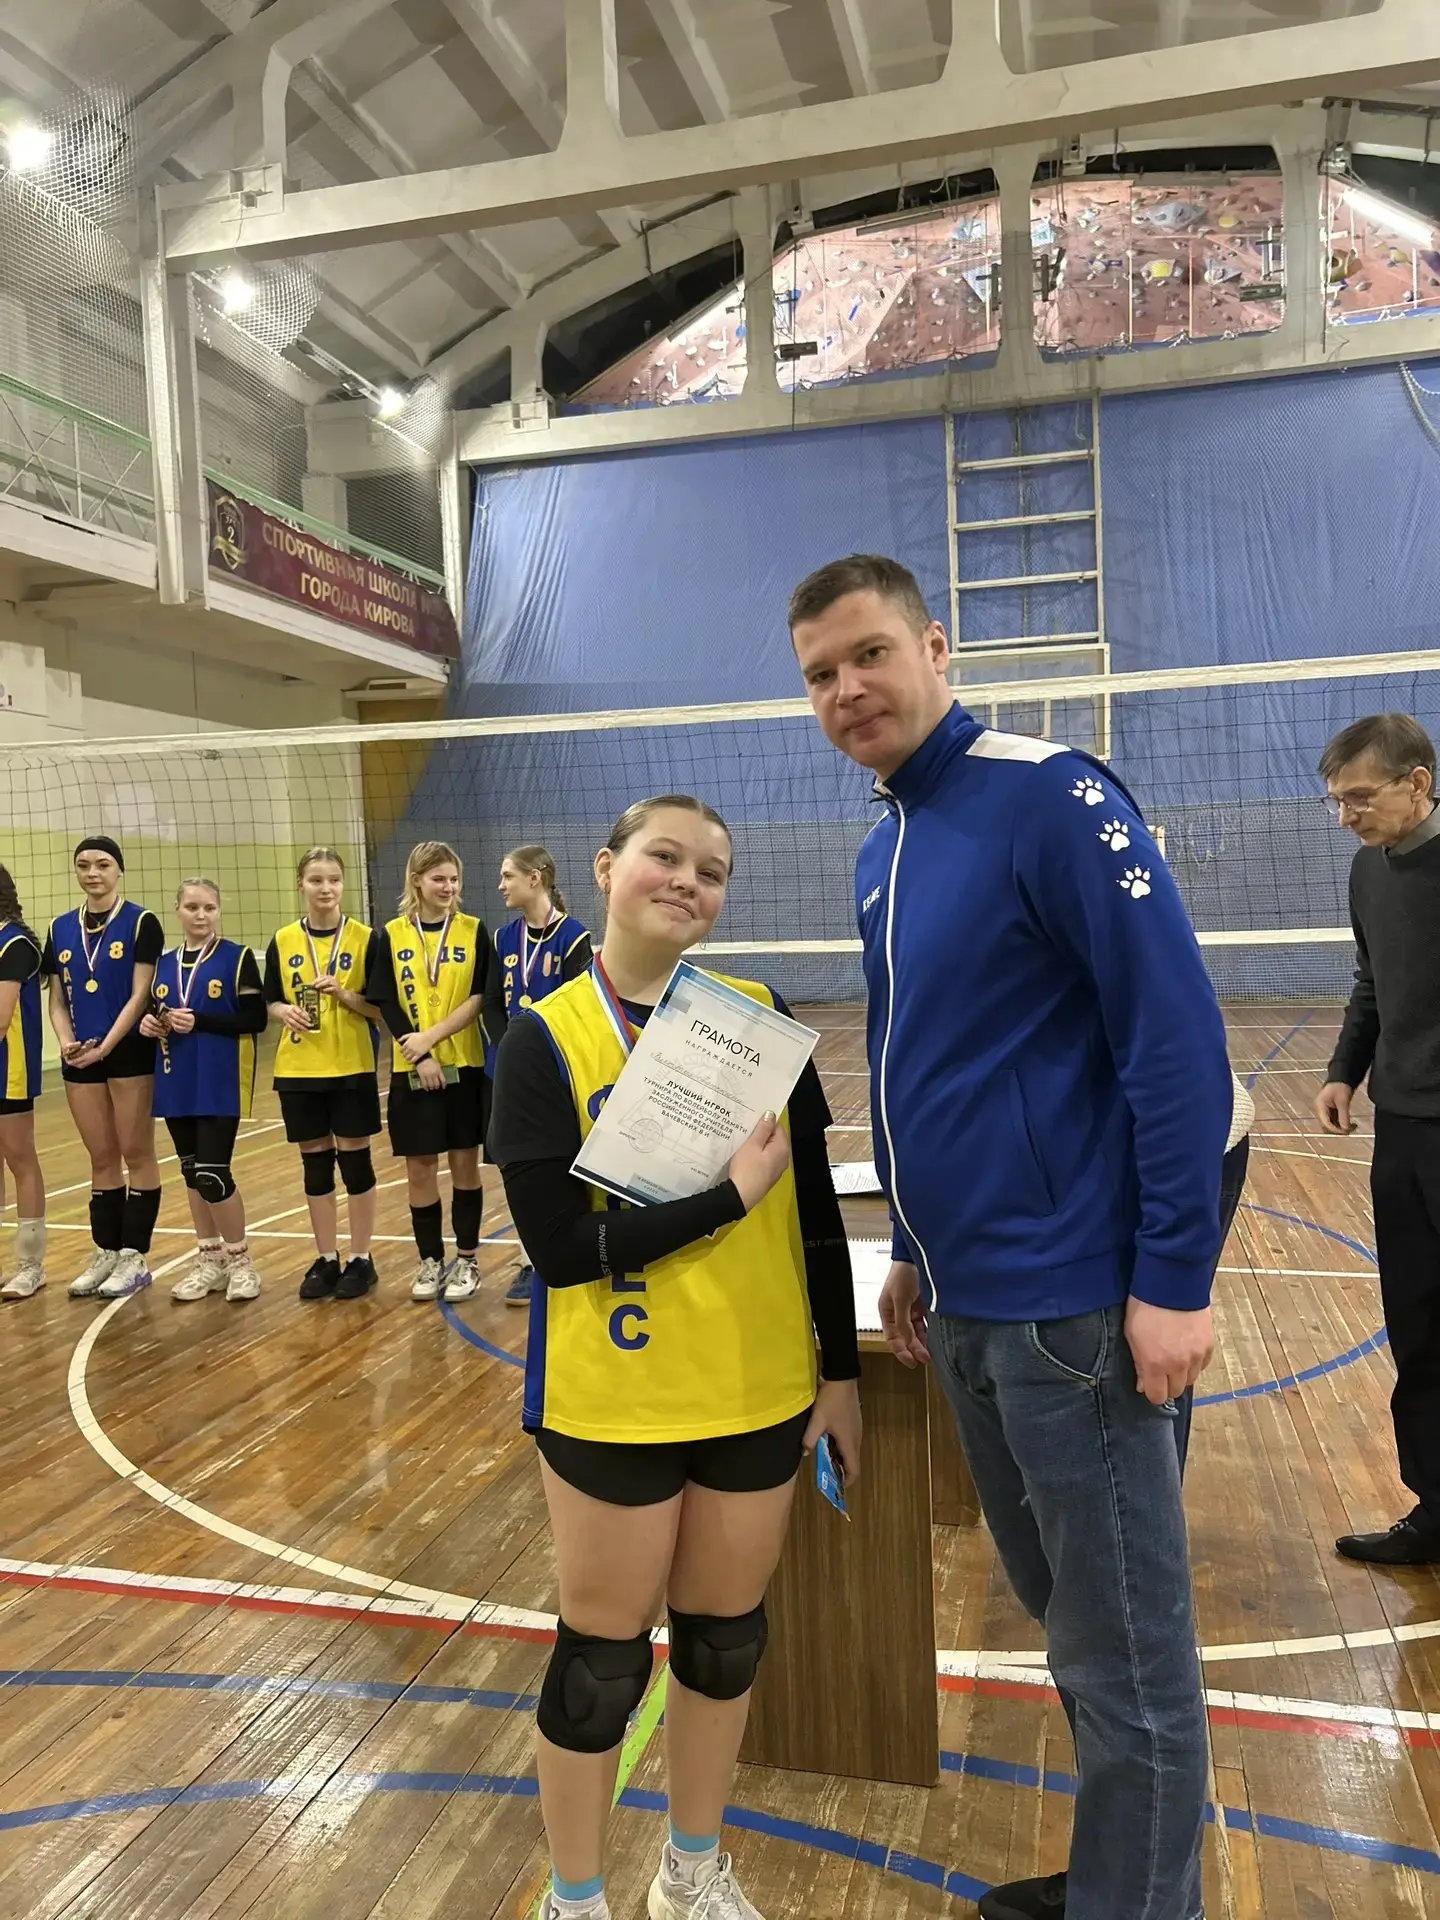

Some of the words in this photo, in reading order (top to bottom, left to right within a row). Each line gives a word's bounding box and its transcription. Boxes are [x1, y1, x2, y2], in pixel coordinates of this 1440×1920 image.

[227, 526, 235, 543] 2
[262, 521, 365, 588] СПОРТИВНАЯ
[368, 571, 417, 612] ШКОЛА
[301, 572, 361, 616] ГОРОДА
[364, 599, 416, 638] КИРОВА
[109, 941, 124, 959] 8
[439, 946, 466, 963] 15
[208, 979, 223, 999] 6
[685, 1039, 753, 1077] НАГРАЖДАЕТСЯ
[690, 1019, 762, 1067] ГРАМОТА
[643, 1076, 672, 1095] ТУРНИРА
[672, 1092, 683, 1100] ПО
[683, 1097, 722, 1120] ВОЛЕЙБОЛУ
[722, 1117, 748, 1134] ПАМЯТИ
[651, 1089, 705, 1119] ЗАСЛУЖЕННОГО
[705, 1117, 734, 1134] УЧИТЕЛЯ
[666, 1080, 703, 1102] ЛУЧШИЙ
[704, 1099, 731, 1117] ИГРОК
[648, 1095, 693, 1121] РОССИЙСКОЙ
[692, 1118, 731, 1141] ФЕДЕРАЦИИ
[661, 1109, 698, 1132] ВАЧЕВСКИХ
[598, 1223, 609, 1262] BIKING
